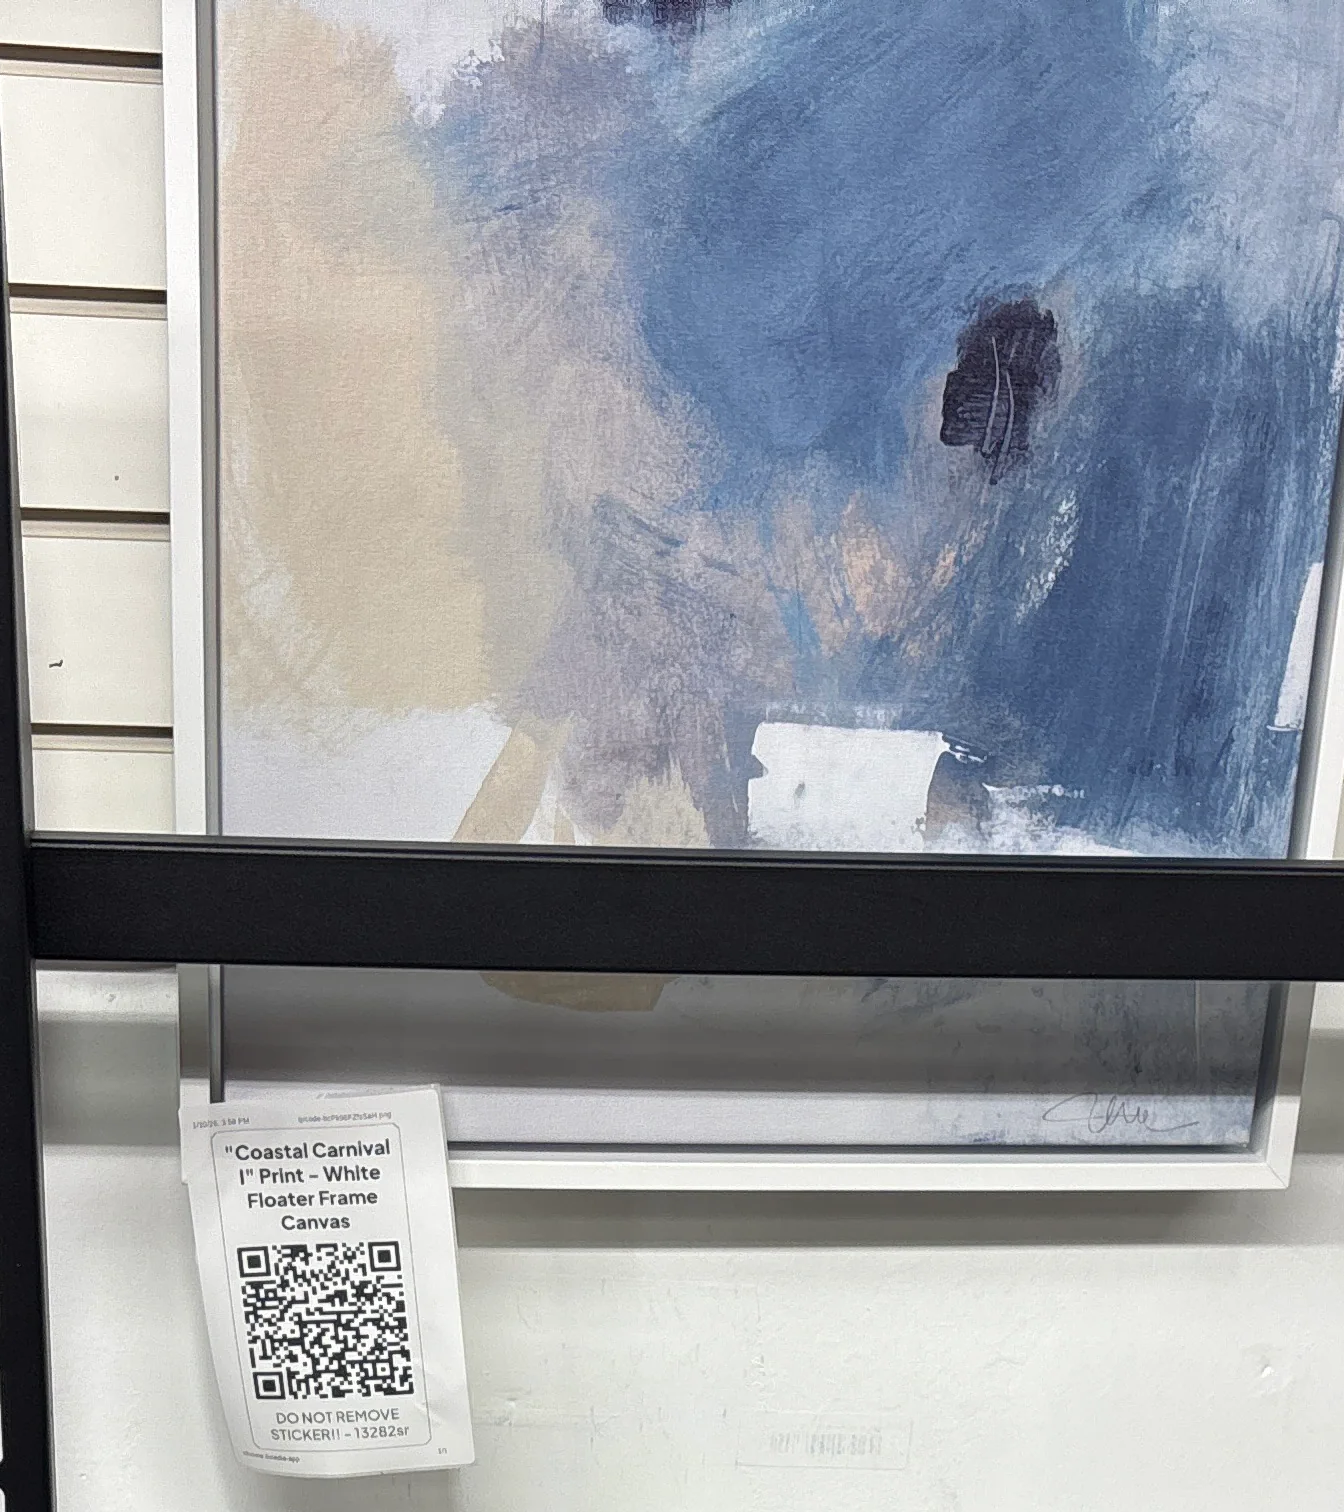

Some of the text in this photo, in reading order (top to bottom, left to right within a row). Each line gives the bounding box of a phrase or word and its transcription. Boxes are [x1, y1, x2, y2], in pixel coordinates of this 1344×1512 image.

[224, 1138, 391, 1161] "Coastal Carnival
[259, 1167, 305, 1184] Print
[322, 1164, 381, 1182] White
[247, 1190, 378, 1209] Floater Frame
[281, 1214, 351, 1231] Canvas
[275, 1407, 401, 1425] DO NOT REMOVE
[270, 1428, 340, 1442] STICKER!!
[354, 1425, 410, 1439] 13282sr
